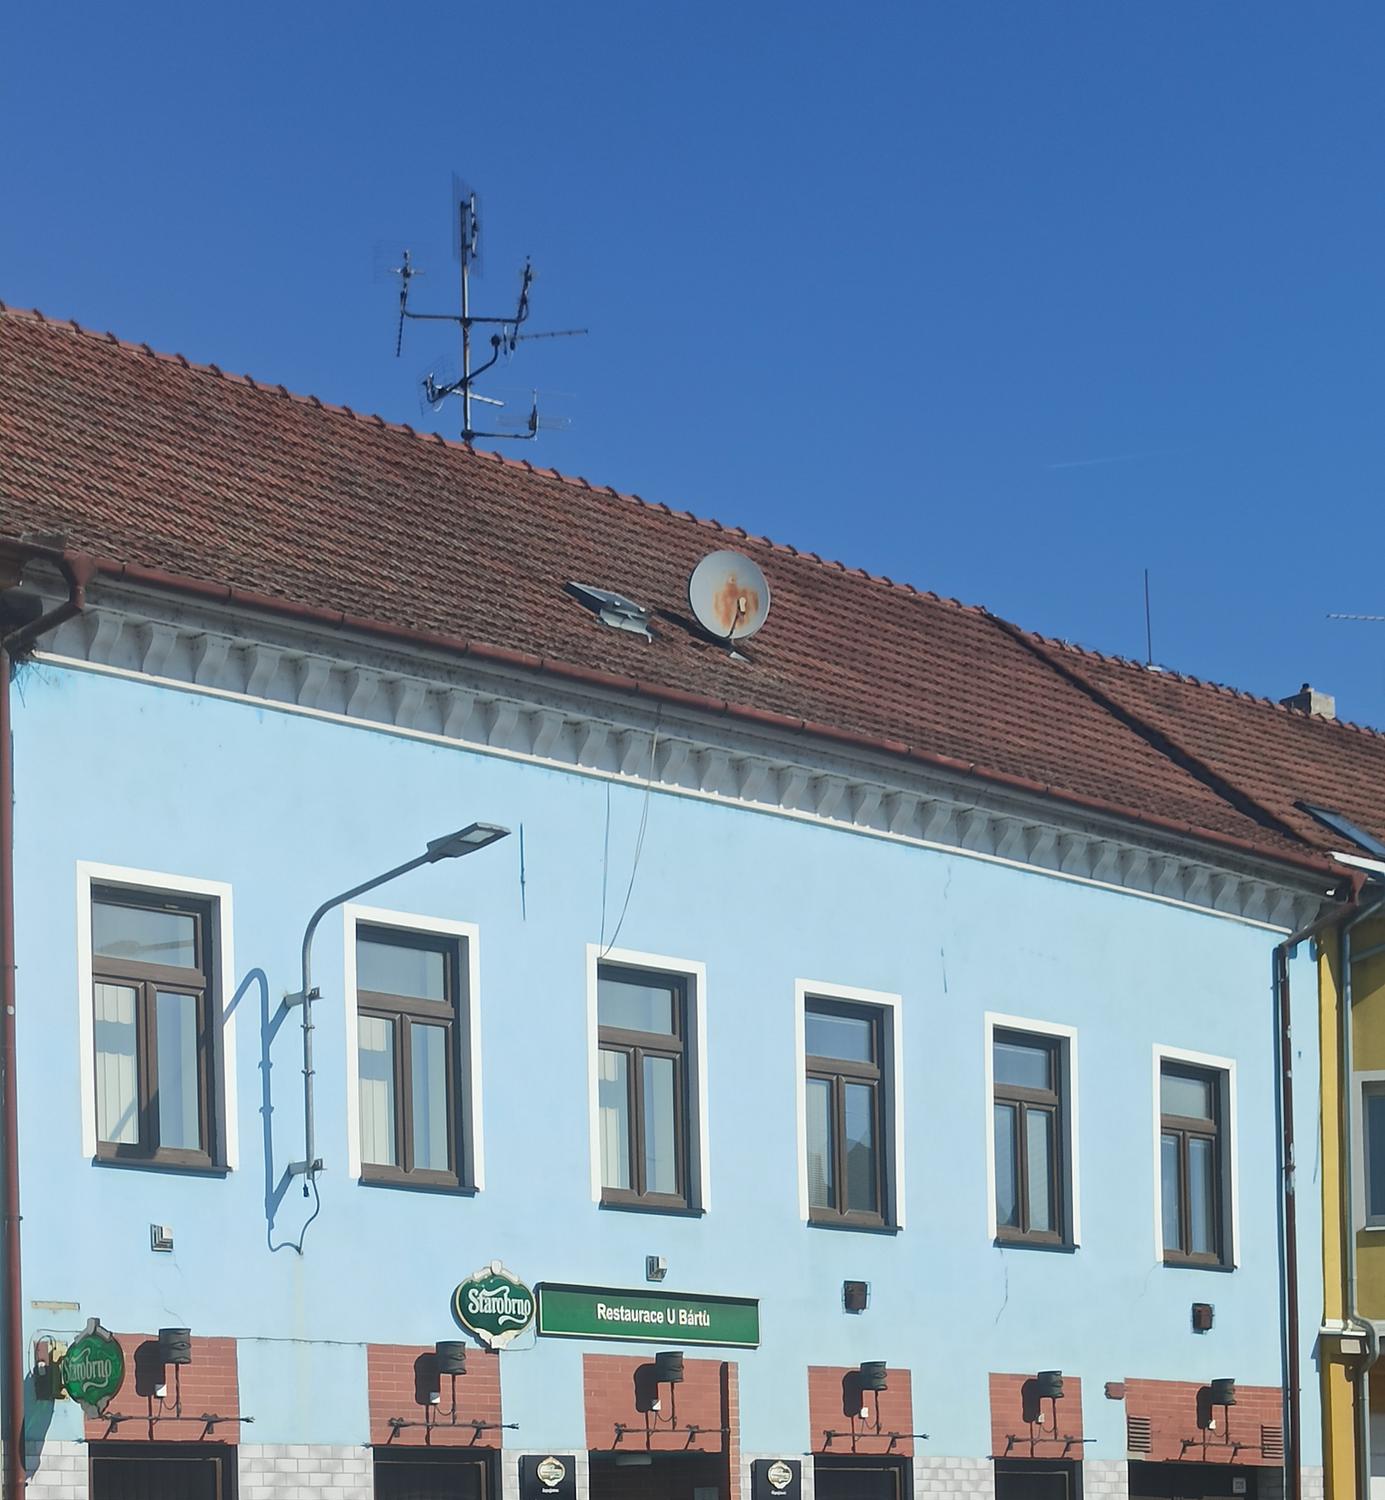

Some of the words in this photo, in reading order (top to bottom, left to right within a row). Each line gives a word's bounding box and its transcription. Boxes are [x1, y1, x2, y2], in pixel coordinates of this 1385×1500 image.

[468, 1285, 531, 1325] Starobrno
[597, 1303, 664, 1324] Restaurace
[667, 1308, 676, 1325] U
[63, 1348, 112, 1392] Starobrno
